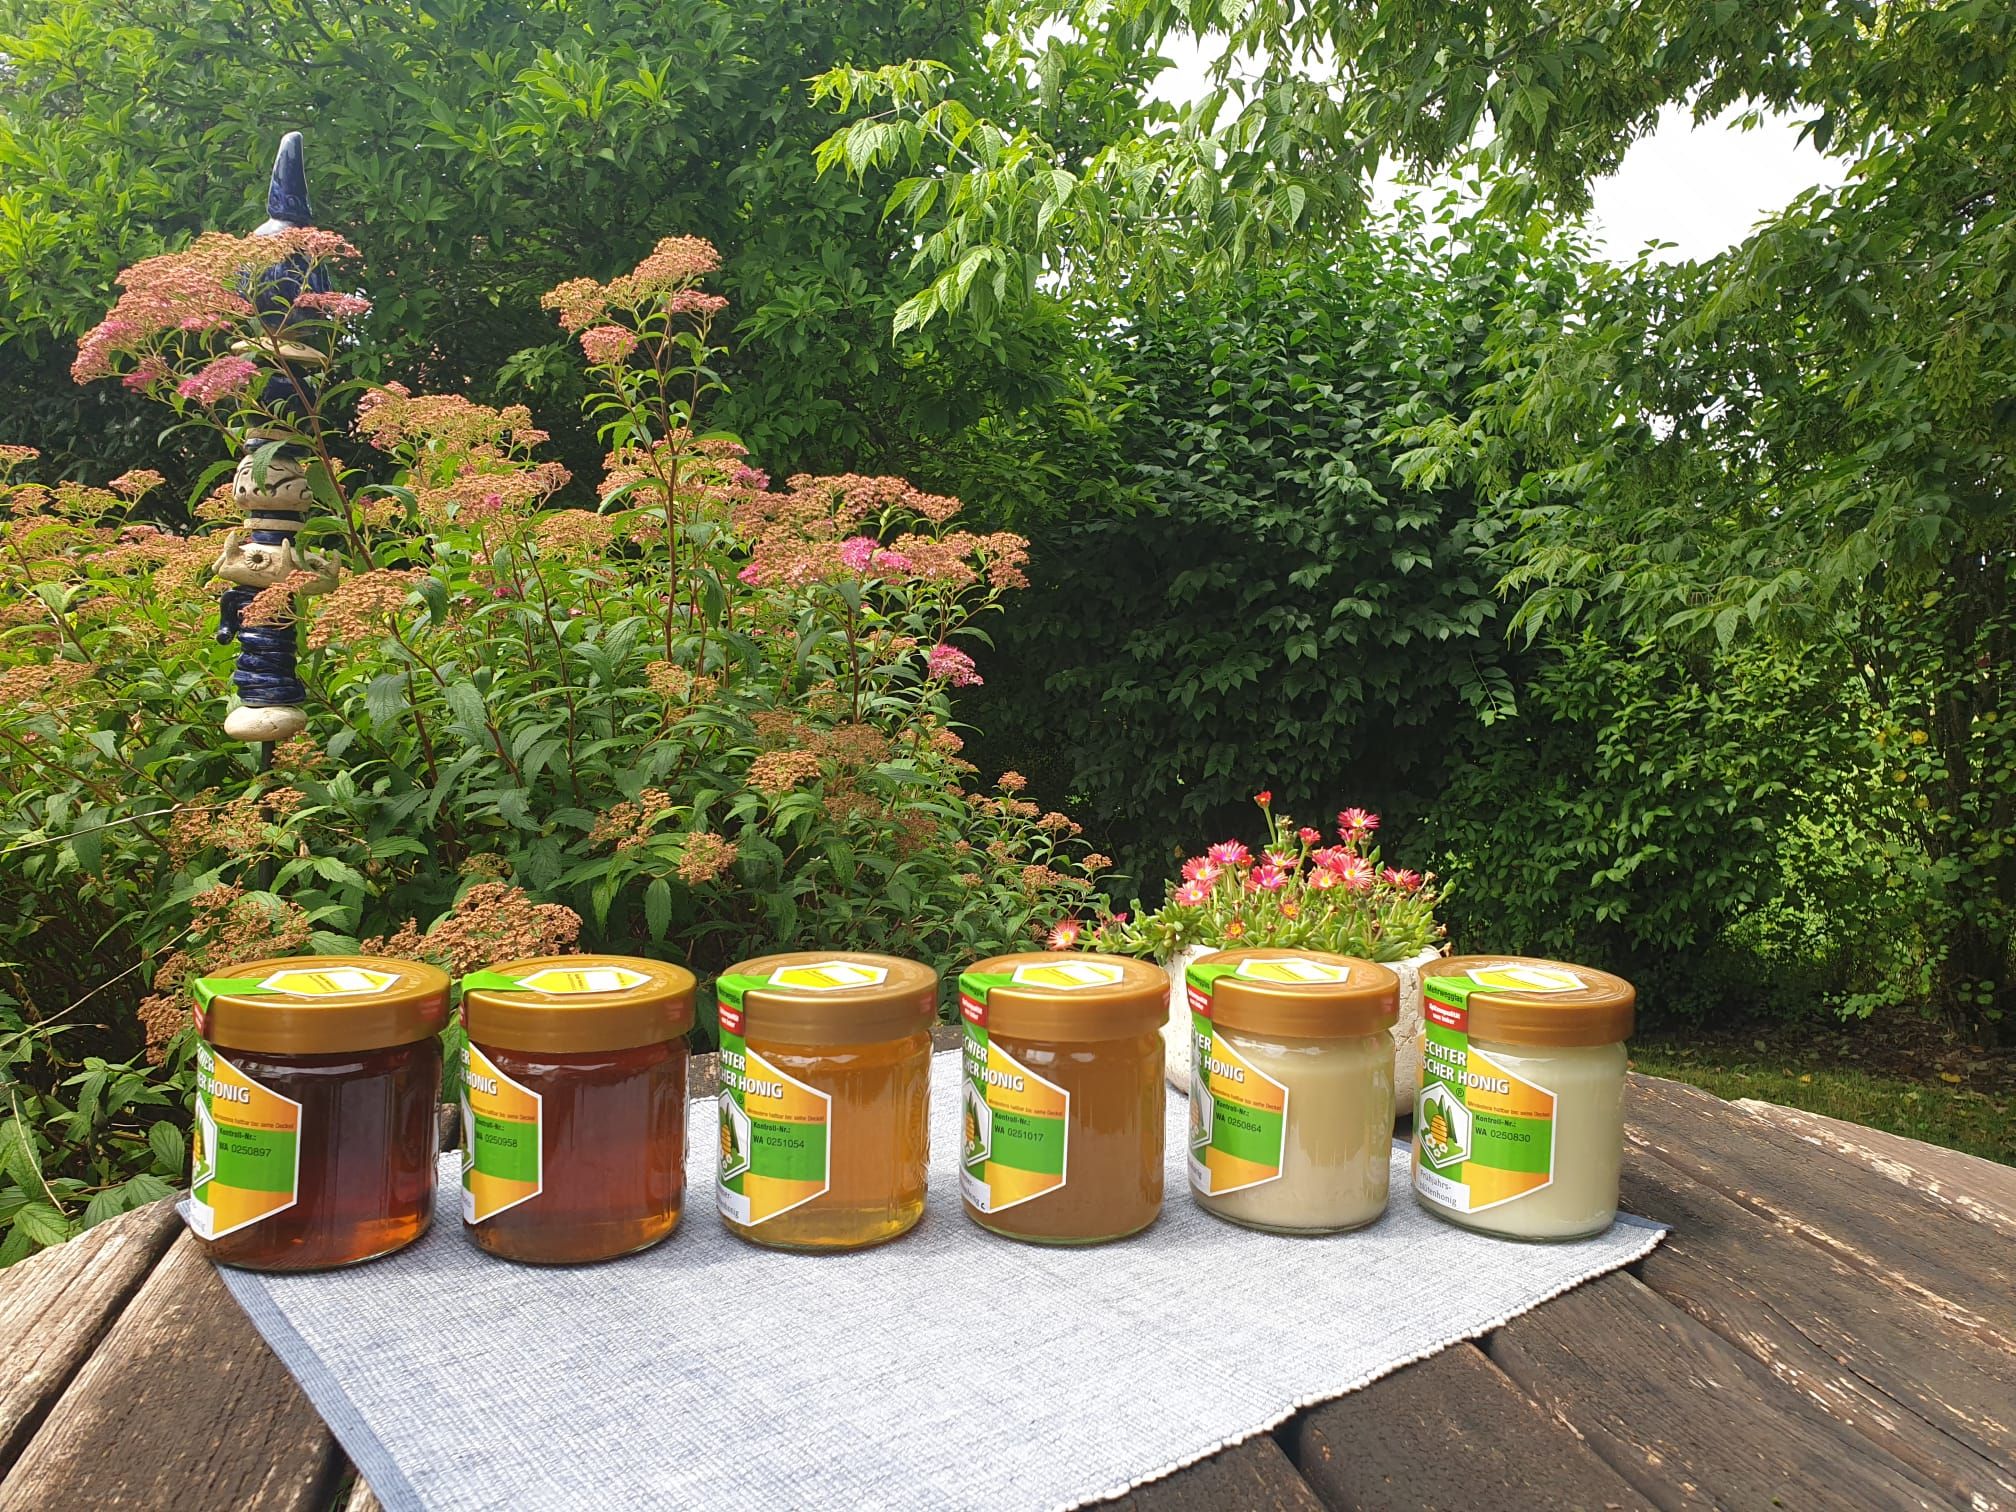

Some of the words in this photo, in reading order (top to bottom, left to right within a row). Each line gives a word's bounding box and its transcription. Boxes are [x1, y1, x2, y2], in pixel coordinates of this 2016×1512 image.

[1425, 1039, 1466, 1066] ECHTER
[1204, 1056, 1244, 1083] HONIG
[466, 1071, 497, 1095] HONIG
[739, 1076, 783, 1099] HONIG
[981, 1066, 1024, 1092] HONIG
[1458, 1069, 1510, 1095] HONIG
[208, 1079, 250, 1103] HONIG
[1216, 1100, 1250, 1117] Kontroll-Nr.:
[753, 1122, 791, 1133] Kontroll-Nr.:
[994, 1112, 1031, 1126] Kontroll-Nr.:
[1216, 1112, 1226, 1122] WA
[1227, 1116, 1262, 1133] 0250864
[1475, 1114, 1517, 1128] Kontroll-Nr.:
[485, 1134, 518, 1147] 0250958
[994, 1124, 1005, 1134] WA
[1007, 1128, 1044, 1141] 0251017
[1475, 1127, 1487, 1136] WA
[1490, 1129, 1531, 1143] 0250830
[753, 1136, 764, 1144] WA
[766, 1137, 805, 1148] 0251054
[232, 1145, 272, 1158] 0250897
